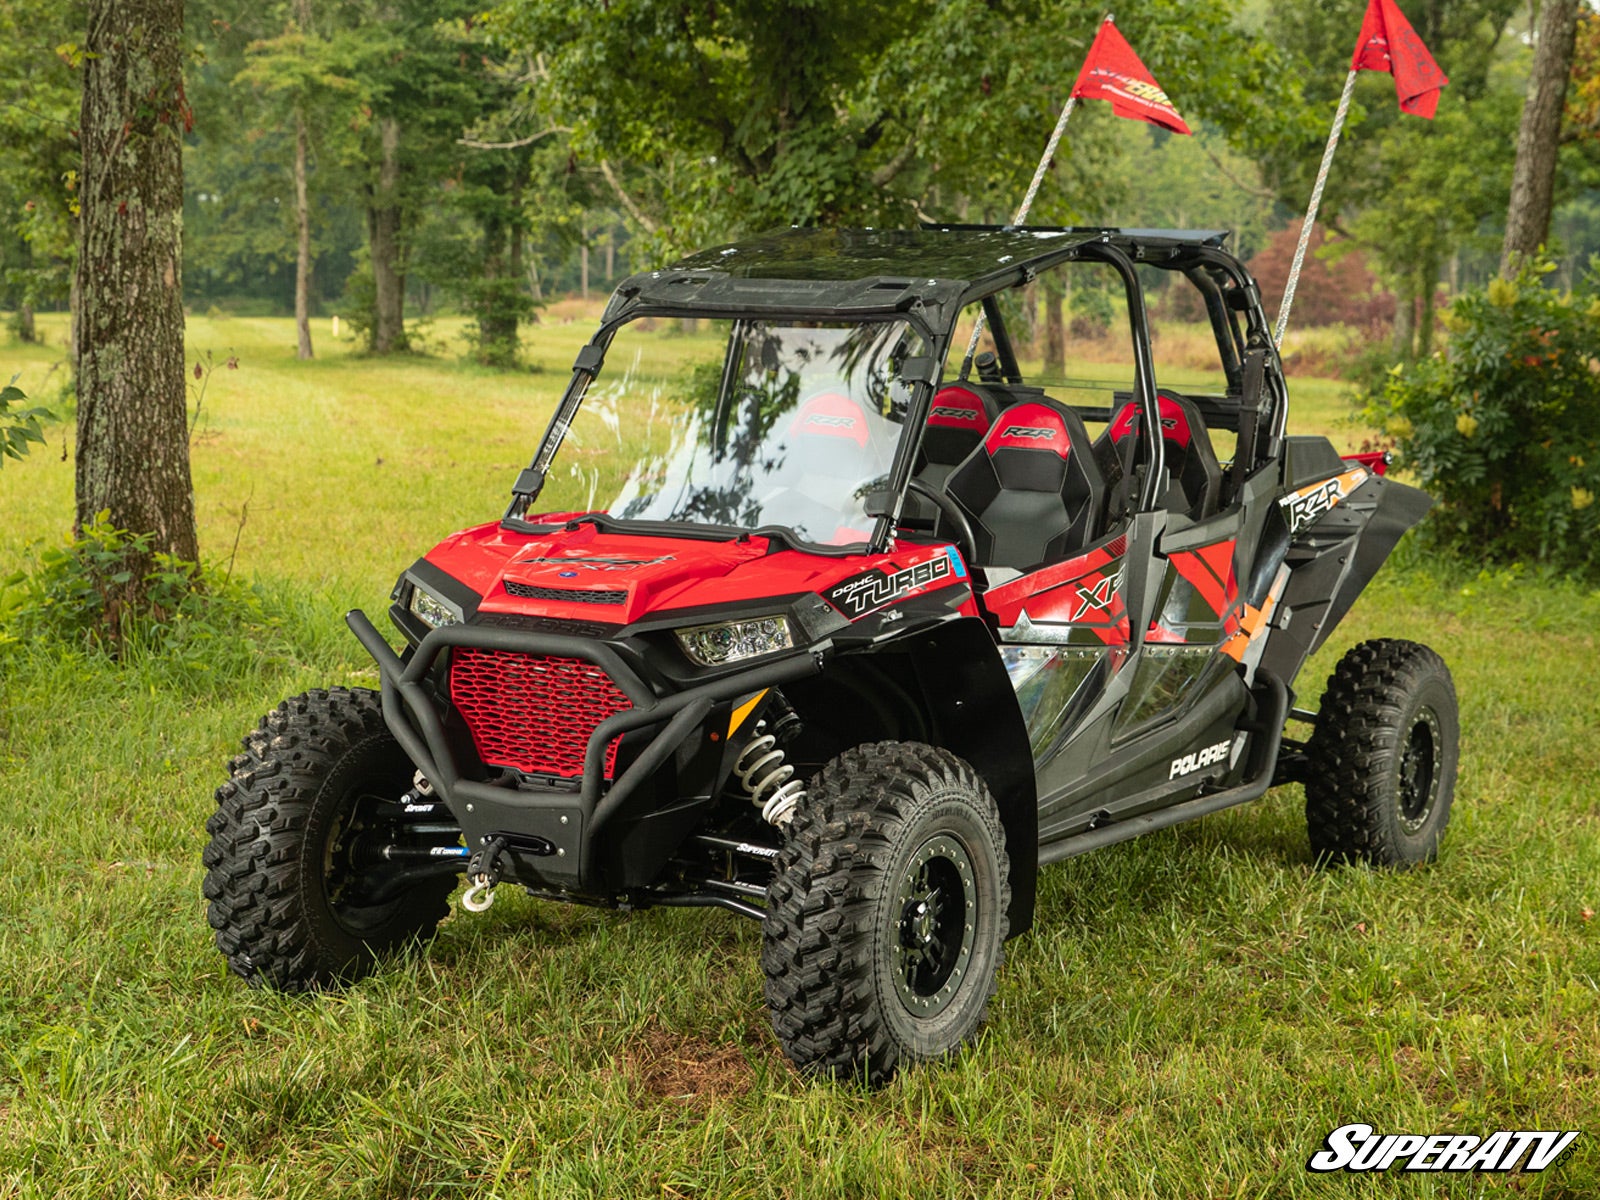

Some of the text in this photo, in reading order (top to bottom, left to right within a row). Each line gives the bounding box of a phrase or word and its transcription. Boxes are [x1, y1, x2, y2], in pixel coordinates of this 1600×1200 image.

[803, 413, 856, 429] RZR
[930, 406, 979, 420] RZR
[1000, 426, 1057, 440] RZR
[1289, 478, 1347, 534] RZR
[832, 574, 875, 598] DOHC
[845, 554, 950, 613] TURBO
[1169, 740, 1231, 780] POLARIS
